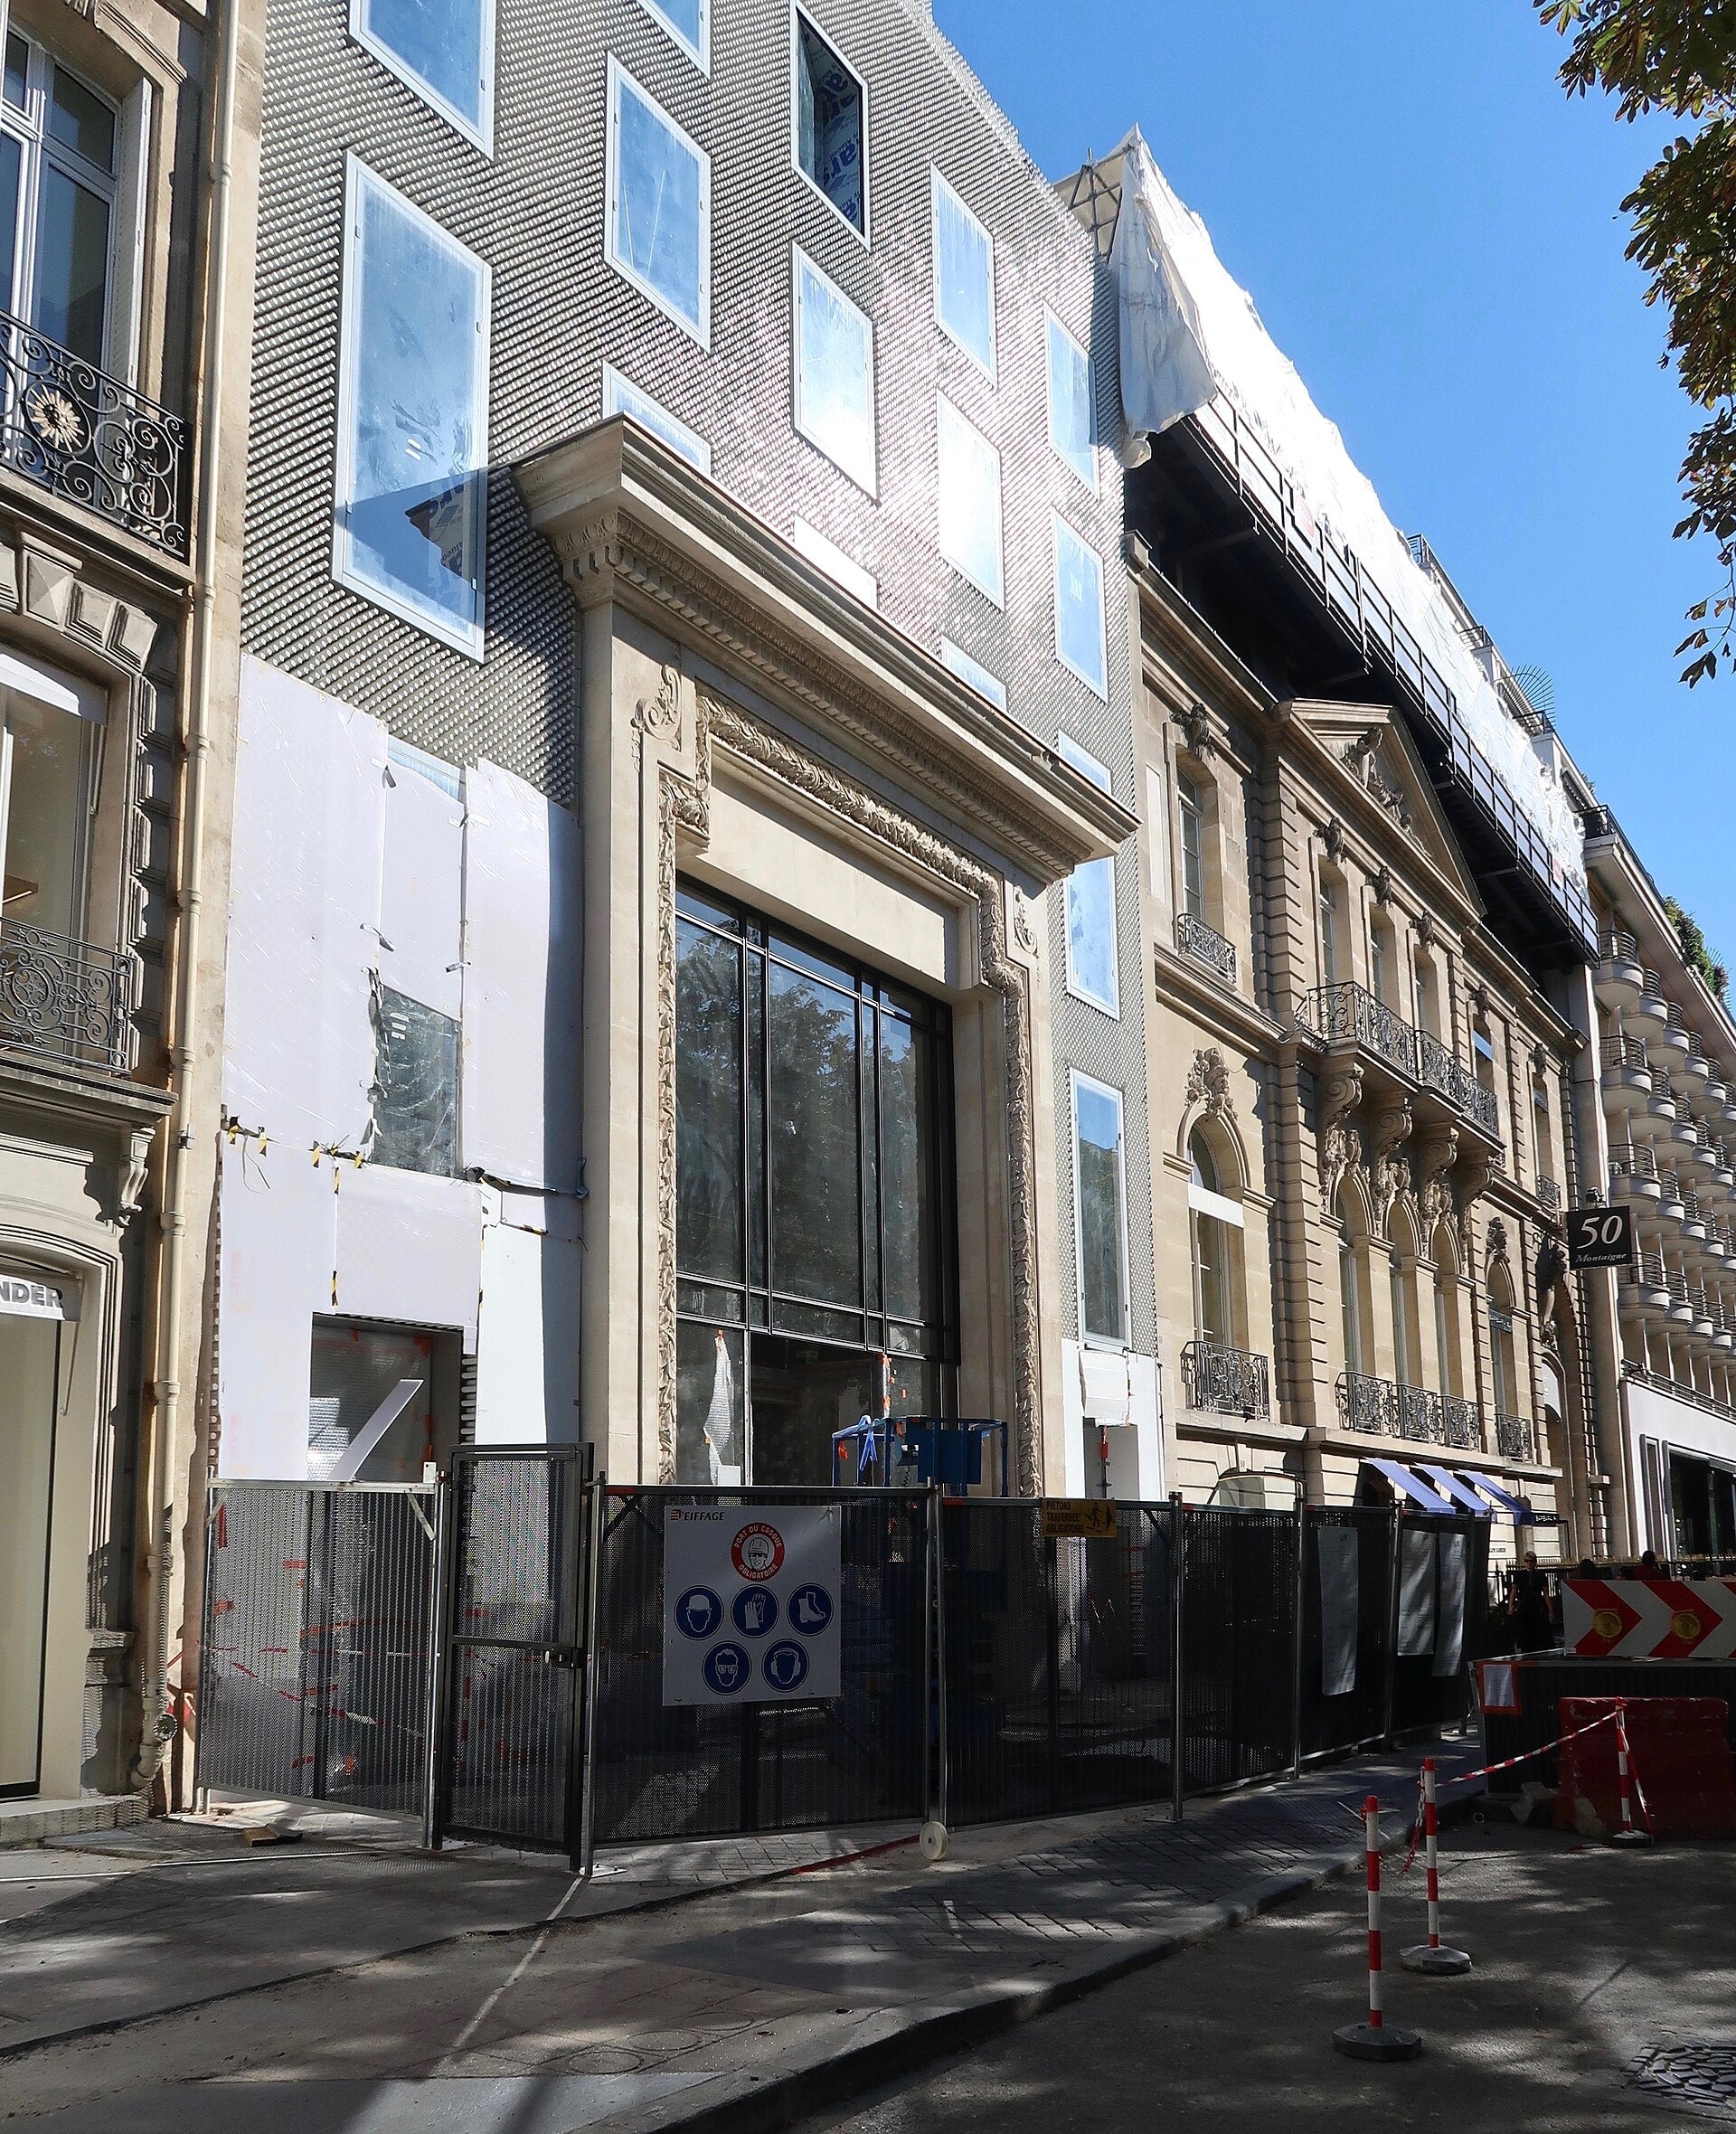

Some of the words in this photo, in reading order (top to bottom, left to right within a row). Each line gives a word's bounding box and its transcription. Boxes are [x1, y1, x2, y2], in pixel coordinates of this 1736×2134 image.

[1577, 1215, 1623, 1249] 50
[1575, 1253, 1628, 1263] Montaigne
[684, 1511, 725, 1521] EIFFAGE
[1046, 1524, 1085, 1534] OBLIGATOIRE
[733, 1530, 748, 1548] PORT
[760, 1525, 783, 1547] CASQUE
[739, 1563, 778, 1579] OBLIGATOIRE
